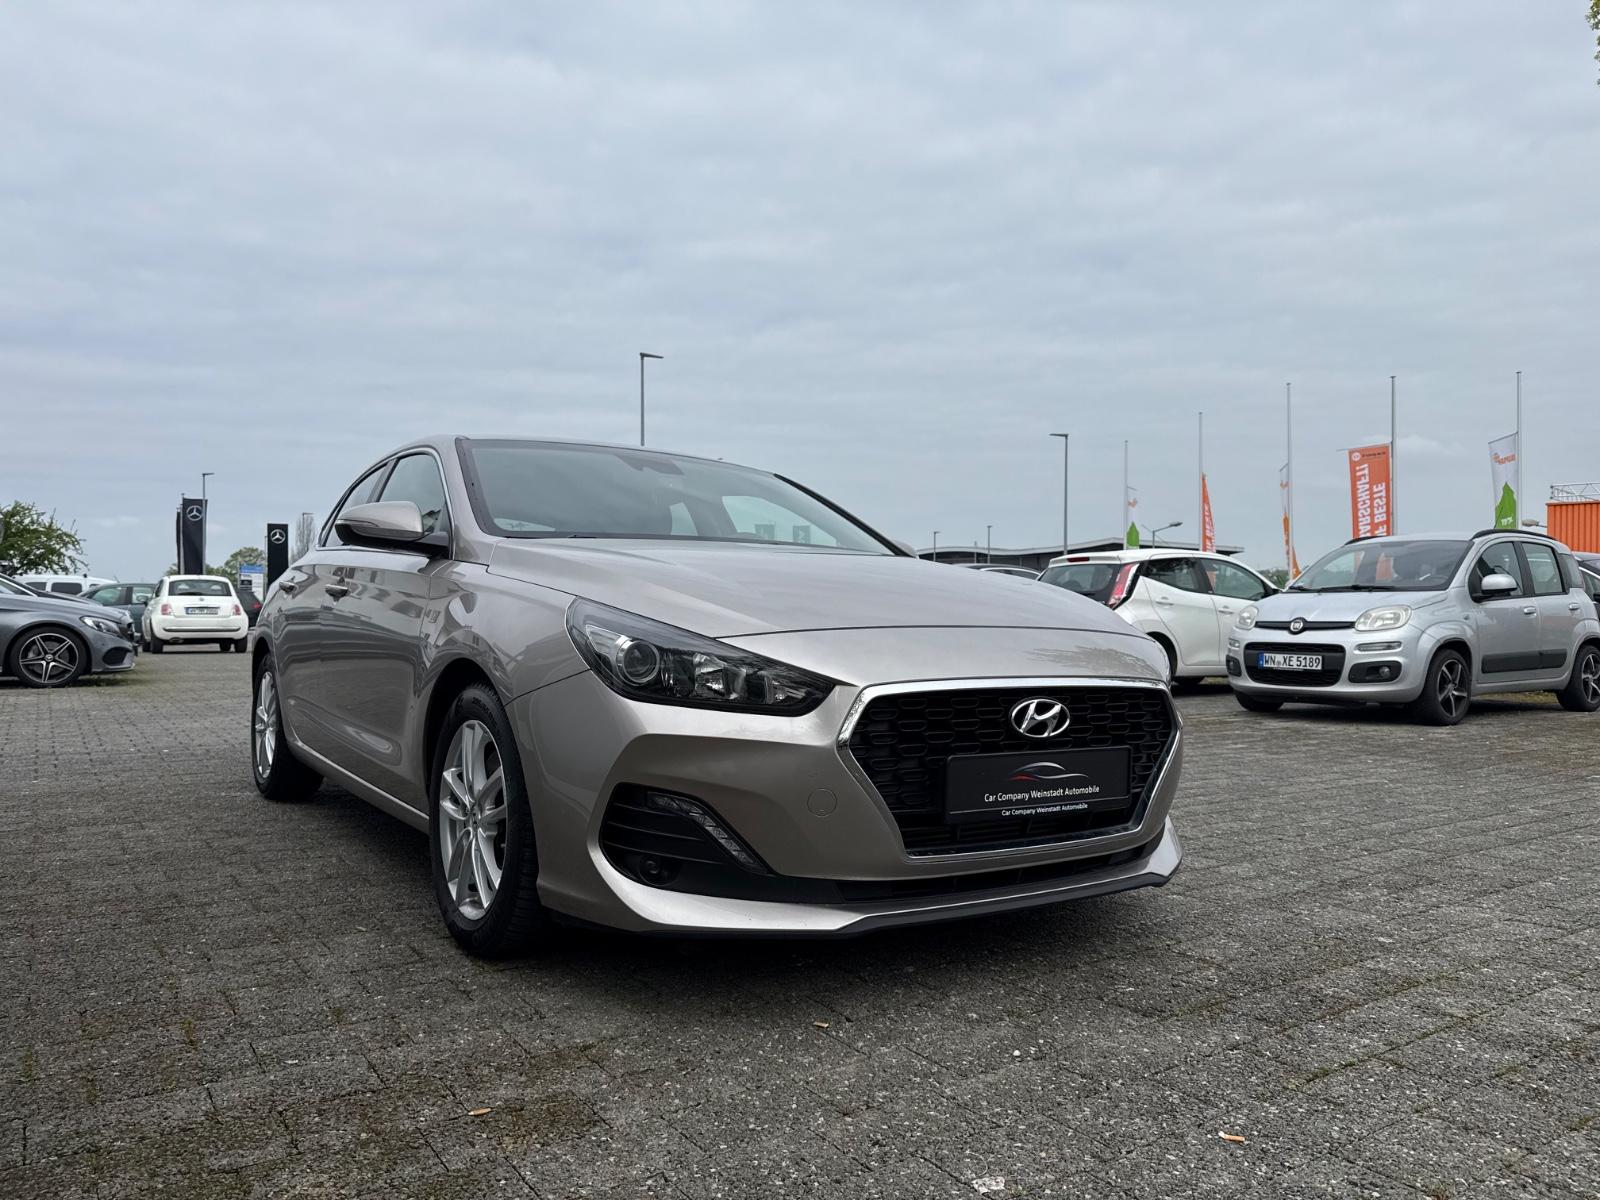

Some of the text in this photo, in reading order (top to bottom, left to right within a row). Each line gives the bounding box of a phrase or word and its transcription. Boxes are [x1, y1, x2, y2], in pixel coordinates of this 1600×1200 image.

[1264, 655, 1321, 668] WN XE 5189
[984, 785, 1100, 802] Car Company Weinstadt Automobile
[1011, 807, 1036, 816] Company
[1036, 805, 1061, 814] Weinstadt
[1061, 803, 1088, 812] Automobile
